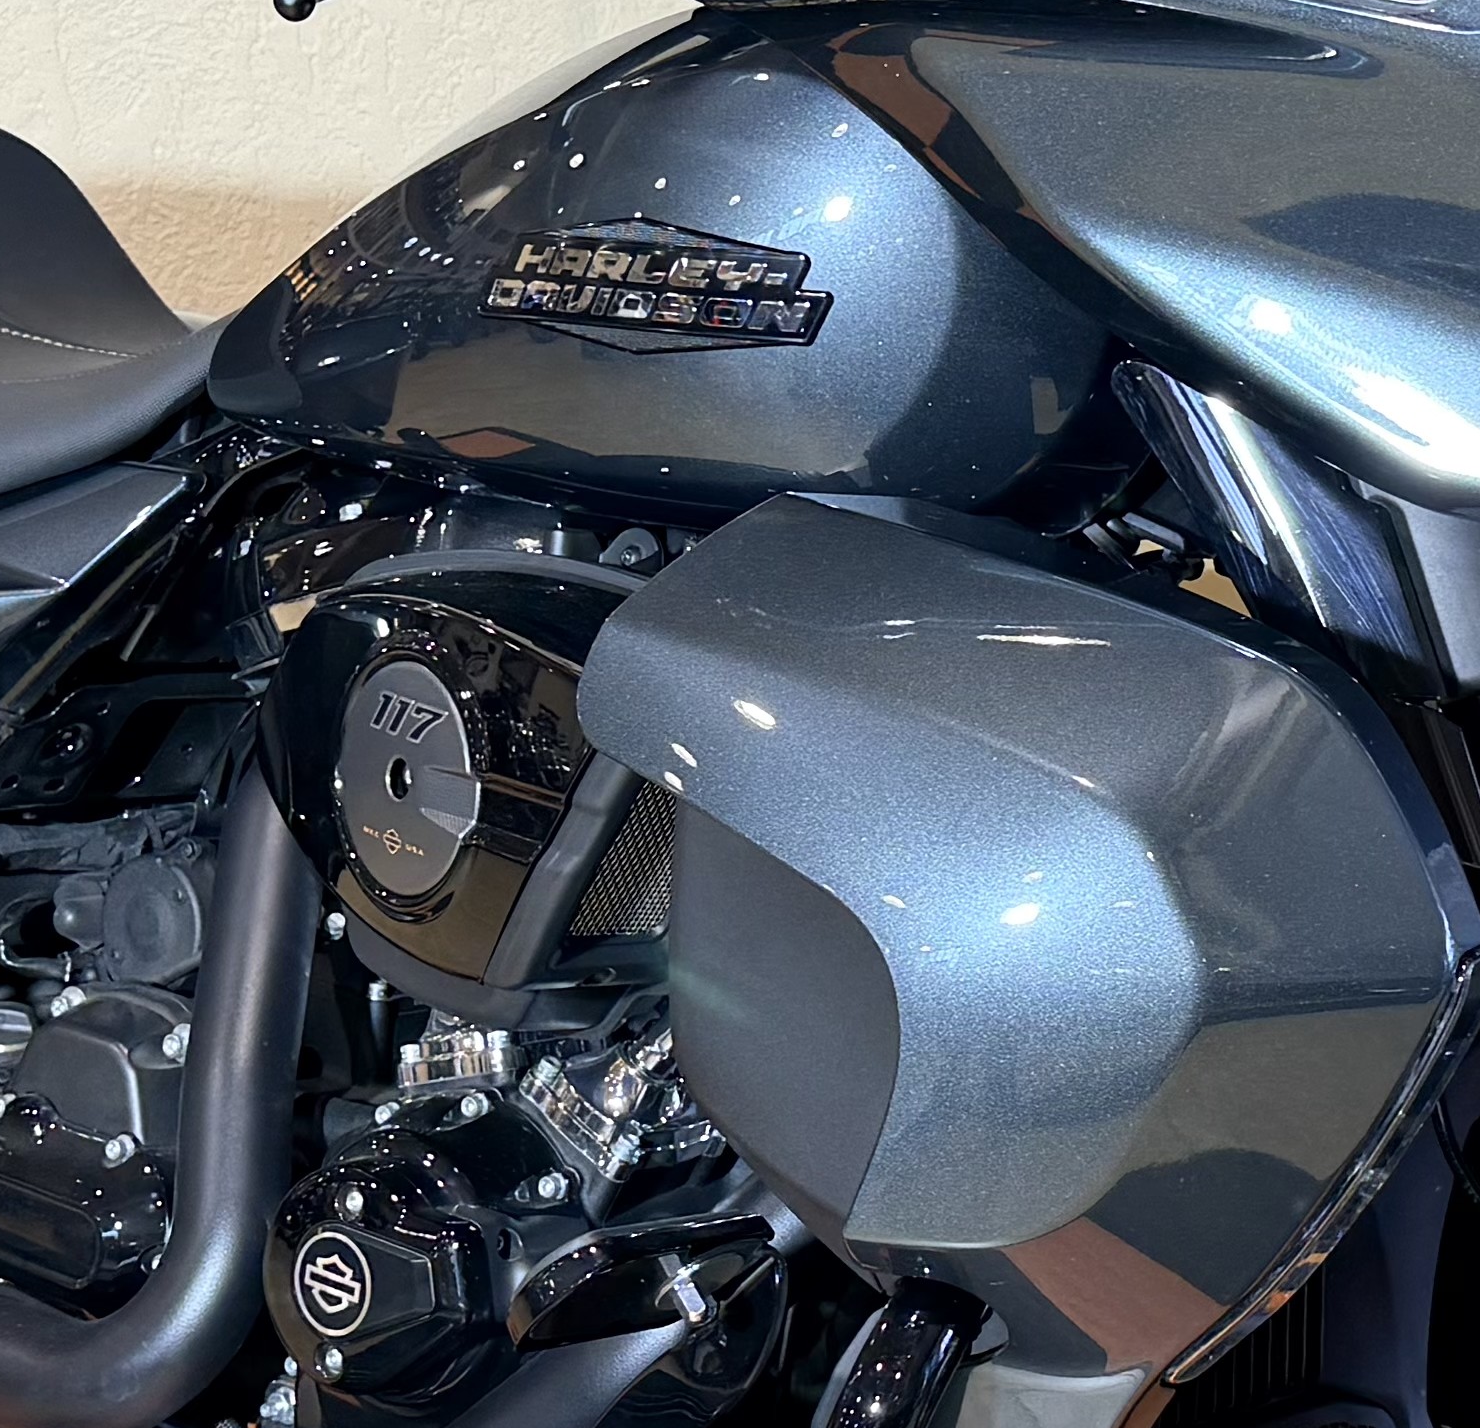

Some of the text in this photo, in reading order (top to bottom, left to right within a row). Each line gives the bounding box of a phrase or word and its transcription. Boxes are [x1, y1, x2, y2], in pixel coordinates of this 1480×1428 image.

[514, 243, 789, 291] HARLEY-
[488, 278, 811, 333] DAVIDSON
[370, 691, 449, 744] 117
